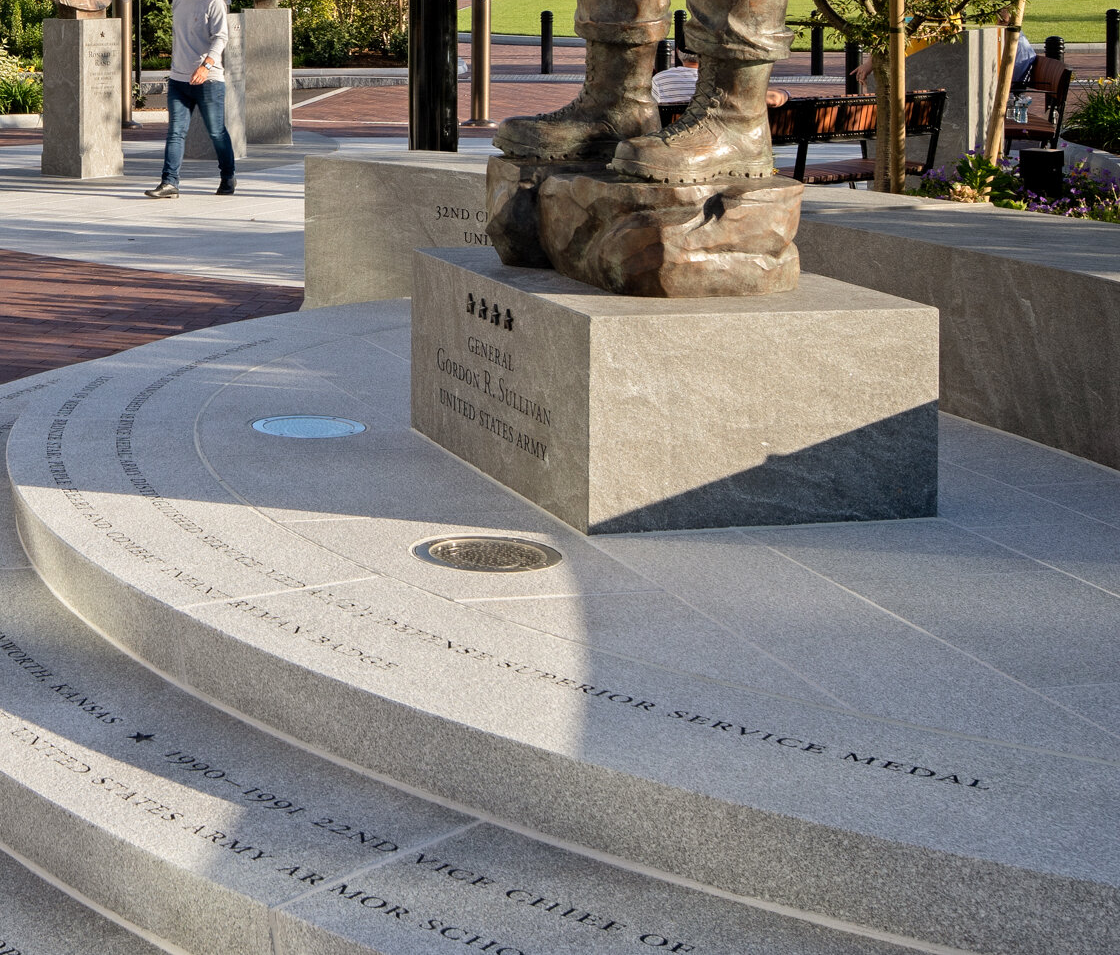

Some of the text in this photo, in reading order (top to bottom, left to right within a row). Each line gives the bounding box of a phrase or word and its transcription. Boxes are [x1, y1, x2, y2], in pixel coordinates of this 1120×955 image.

[435, 205, 470, 221] 32ND
[463, 232, 494, 246] UNI
[436, 347, 551, 427] GORDON R. SULLIVAN
[467, 335, 514, 372] GENERAL
[438, 388, 547, 462] UNITED STATES ARMY
[48, 460, 72, 485] PURPLE
[61, 487, 94, 510] HEART
[82, 512, 113, 530] AND
[106, 531, 166, 564] COMBAT
[307, 635, 399, 670] BADGE
[130, 478, 203, 534] DISTINGUISHED
[197, 534, 264, 570] SERVICE
[496, 659, 658, 712] SUPERIOR
[667, 709, 825, 754] SERVICE
[840, 751, 991, 791] MEDAL
[11, 727, 91, 774] UNITED
[91, 776, 184, 822] STATES
[182, 824, 274, 862] ARMY
[50, 683, 124, 725] KANSAS
[312, 817, 399, 853] 22ND
[413, 853, 496, 889] VICE
[505, 889, 627, 933] CHIEF
[639, 932, 696, 954] OF
